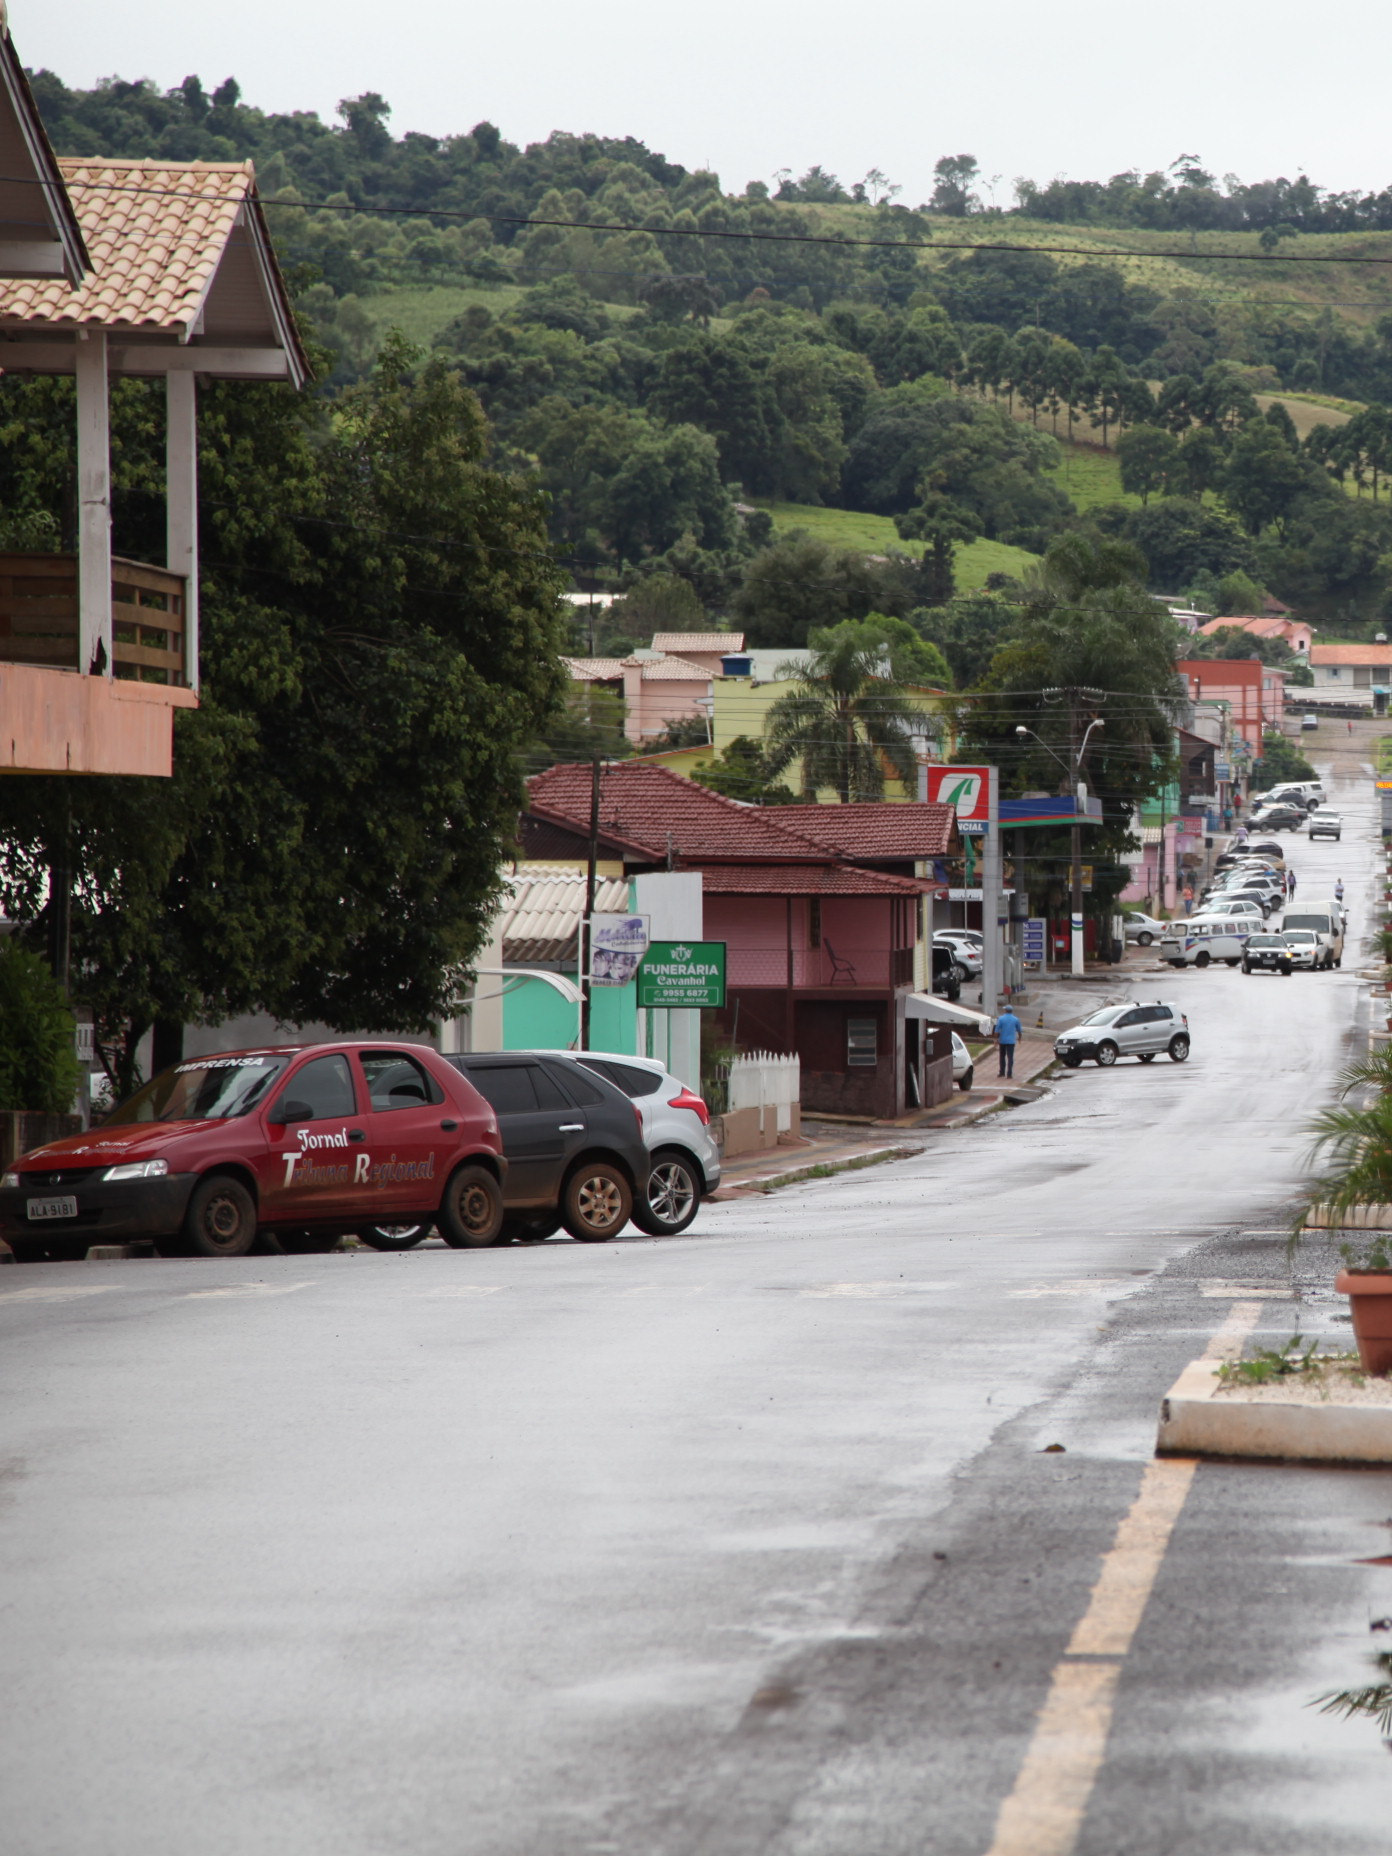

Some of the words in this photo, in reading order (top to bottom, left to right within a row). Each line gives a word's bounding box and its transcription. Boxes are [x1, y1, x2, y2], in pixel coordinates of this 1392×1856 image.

[958, 823, 983, 831] NCIAL
[644, 963, 718, 975] FUNERÁRIA
[657, 976, 706, 986] Cavanhol
[174, 1057, 265, 1074] IMPRENSA
[297, 1127, 349, 1152] Jornal
[282, 1152, 349, 1189] Tribuna
[353, 1151, 435, 1191] Regional
[29, 1204, 73, 1218] ALA-9181
